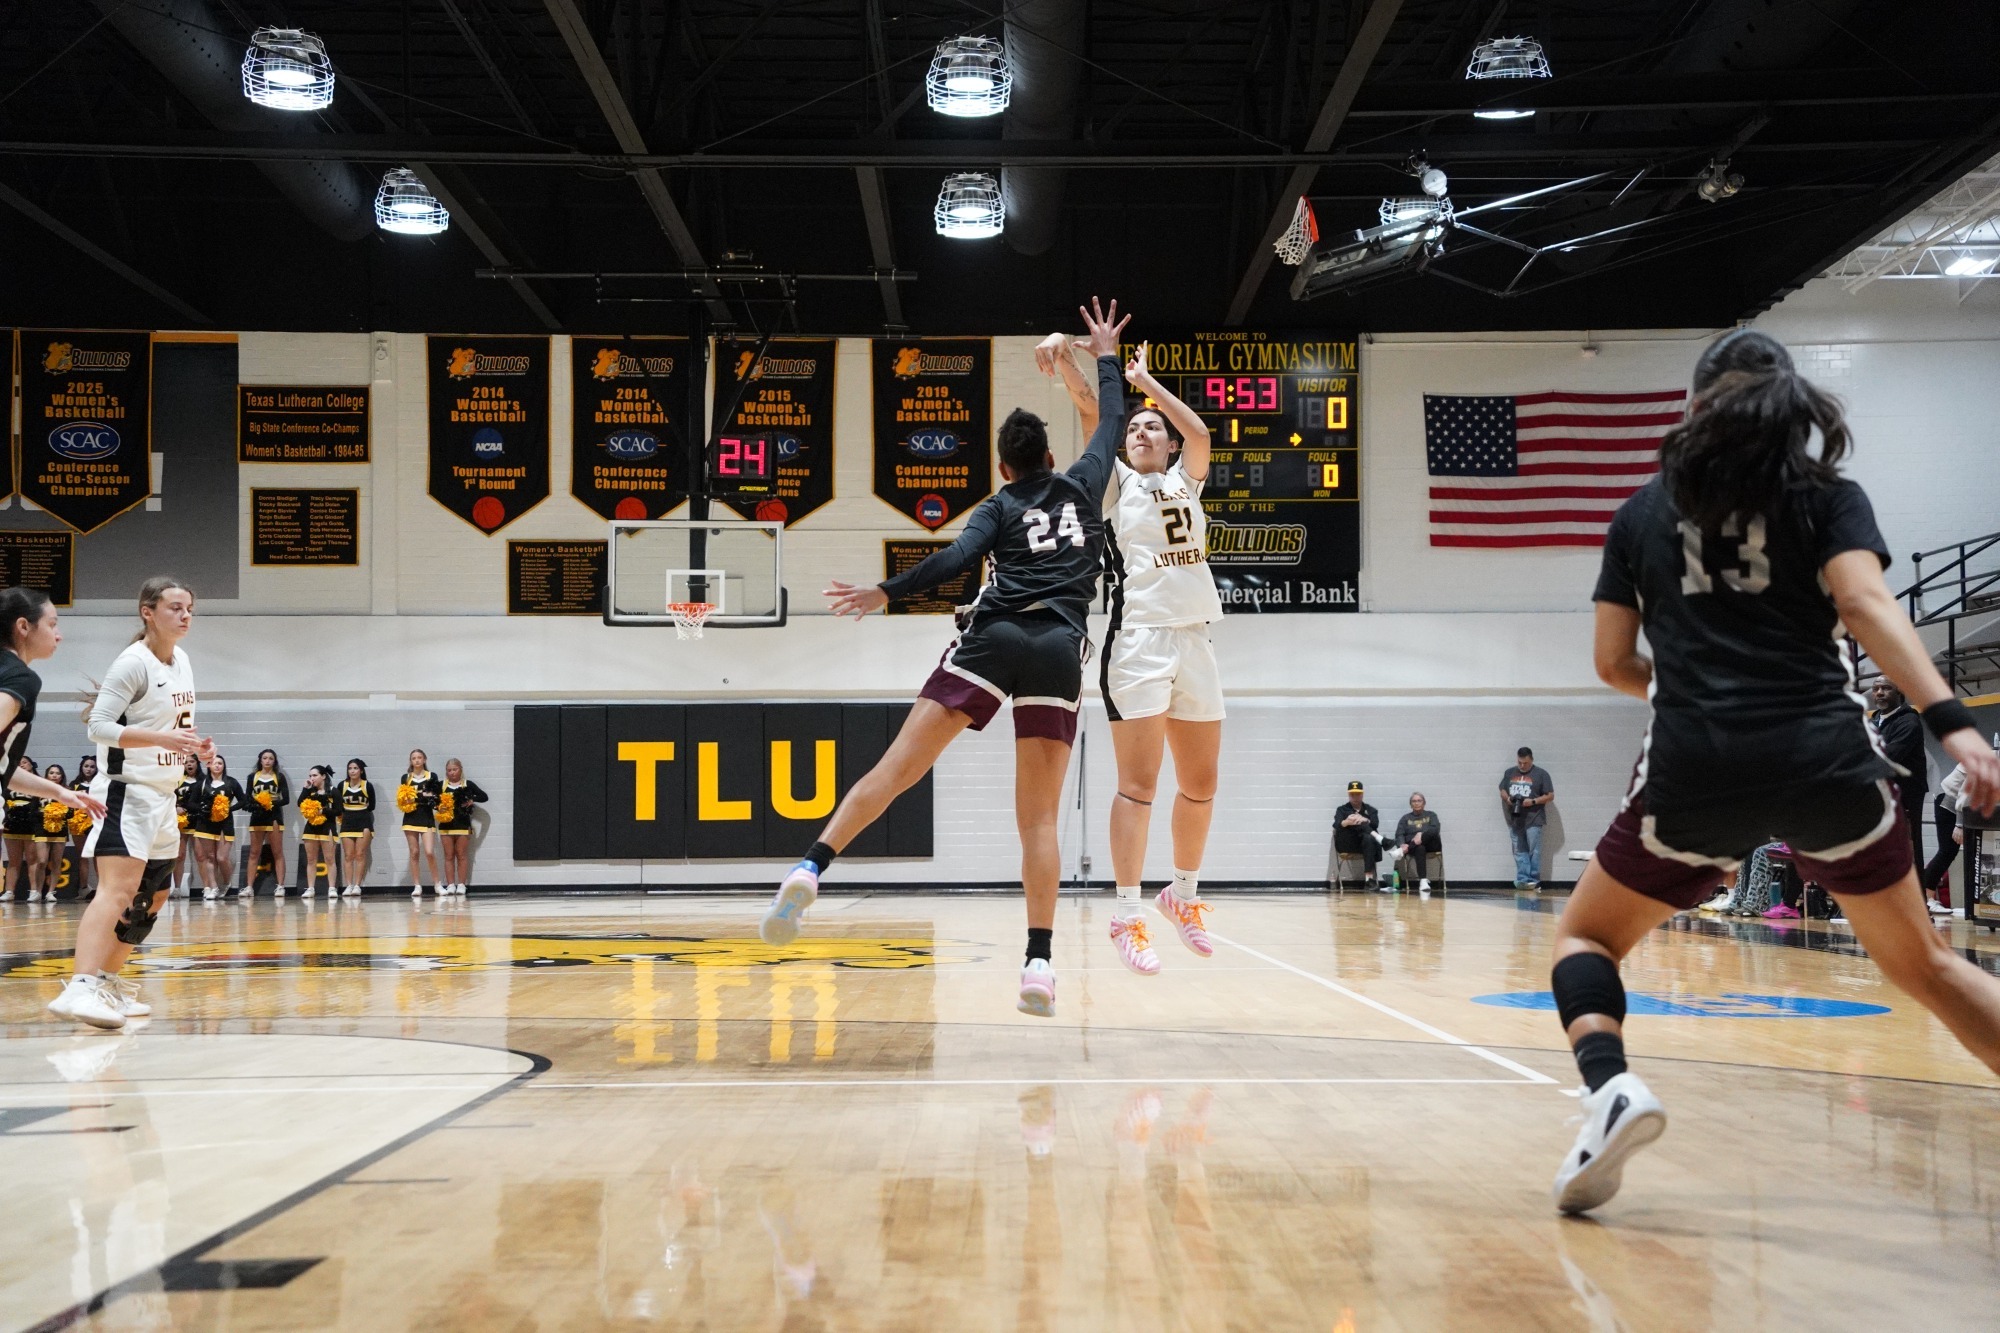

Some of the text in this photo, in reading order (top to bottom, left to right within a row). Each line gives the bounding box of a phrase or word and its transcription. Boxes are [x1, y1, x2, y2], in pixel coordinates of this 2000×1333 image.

[1195, 332, 1266, 341] WELCOME TO
[72, 348, 131, 367] BULLDOGS
[1116, 342, 1356, 371] EORIAL GYMNASIUM
[475, 354, 530, 372] BULLDOGS
[762, 357, 816, 375] BULLDOGS
[920, 354, 974, 372] BULLDOGS
[67, 382, 104, 394] 2025
[1298, 378, 1347, 393] VISITOR
[472, 387, 505, 399] 2014
[617, 388, 648, 400] 2014
[759, 390, 791, 402] 2015
[917, 386, 949, 398] 2019
[1206, 378, 1277, 410] 9:53
[52, 394, 119, 406] Women's
[246, 392, 365, 411] Texas Lutheran College
[457, 399, 520, 411] Women's
[601, 400, 663, 412] Women's
[902, 398, 963, 410] Women's
[45, 406, 125, 418] Basketball
[744, 402, 806, 414] Women's
[1328, 396, 1347, 429] 0
[451, 411, 526, 422] Basketball
[738, 414, 812, 426] Basketball
[896, 410, 970, 422] Basketball
[250, 422, 360, 435] Big State Conference Co-Champs
[1232, 419, 1238, 443] 1
[1244, 426, 1269, 435] PERIOD
[60, 432, 110, 449] SCAC
[610, 436, 655, 453] SCAC
[911, 435, 955, 451] SCAC
[246, 444, 282, 457] Women's
[284, 444, 326, 457] Basketball
[334, 444, 364, 457] 1984-85
[475, 443, 503, 452] NCAA
[720, 438, 765, 476] 24
[1210, 452, 1272, 463] AYER FOULS
[1308, 452, 1337, 463] FOULS
[48, 462, 120, 473] Conference
[452, 466, 527, 478] Tournament
[594, 466, 668, 478] Conference
[896, 465, 969, 476] Conference
[38, 474, 130, 484] and Co-Season
[1323, 464, 1339, 488] 0
[464, 478, 516, 490] 1st Round
[595, 478, 666, 491] Champions
[897, 477, 968, 489] Champions
[50, 485, 119, 496] Champions
[1229, 490, 1250, 498] GAME
[1313, 490, 1331, 498] WON
[1229, 504, 1245, 512] OF
[1250, 503, 1276, 512] THE
[1022, 502, 1086, 553] 24
[16, 536, 66, 544] Basketball
[1208, 523, 1303, 554] BULLDOGS
[1153, 548, 1206, 568] LUTHER
[1677, 511, 1771, 596] 13
[1216, 581, 1356, 604] mercial Bank
[172, 691, 194, 707] TEXAS
[618, 740, 836, 820] TLU
[343, 796, 368, 805] TLU
